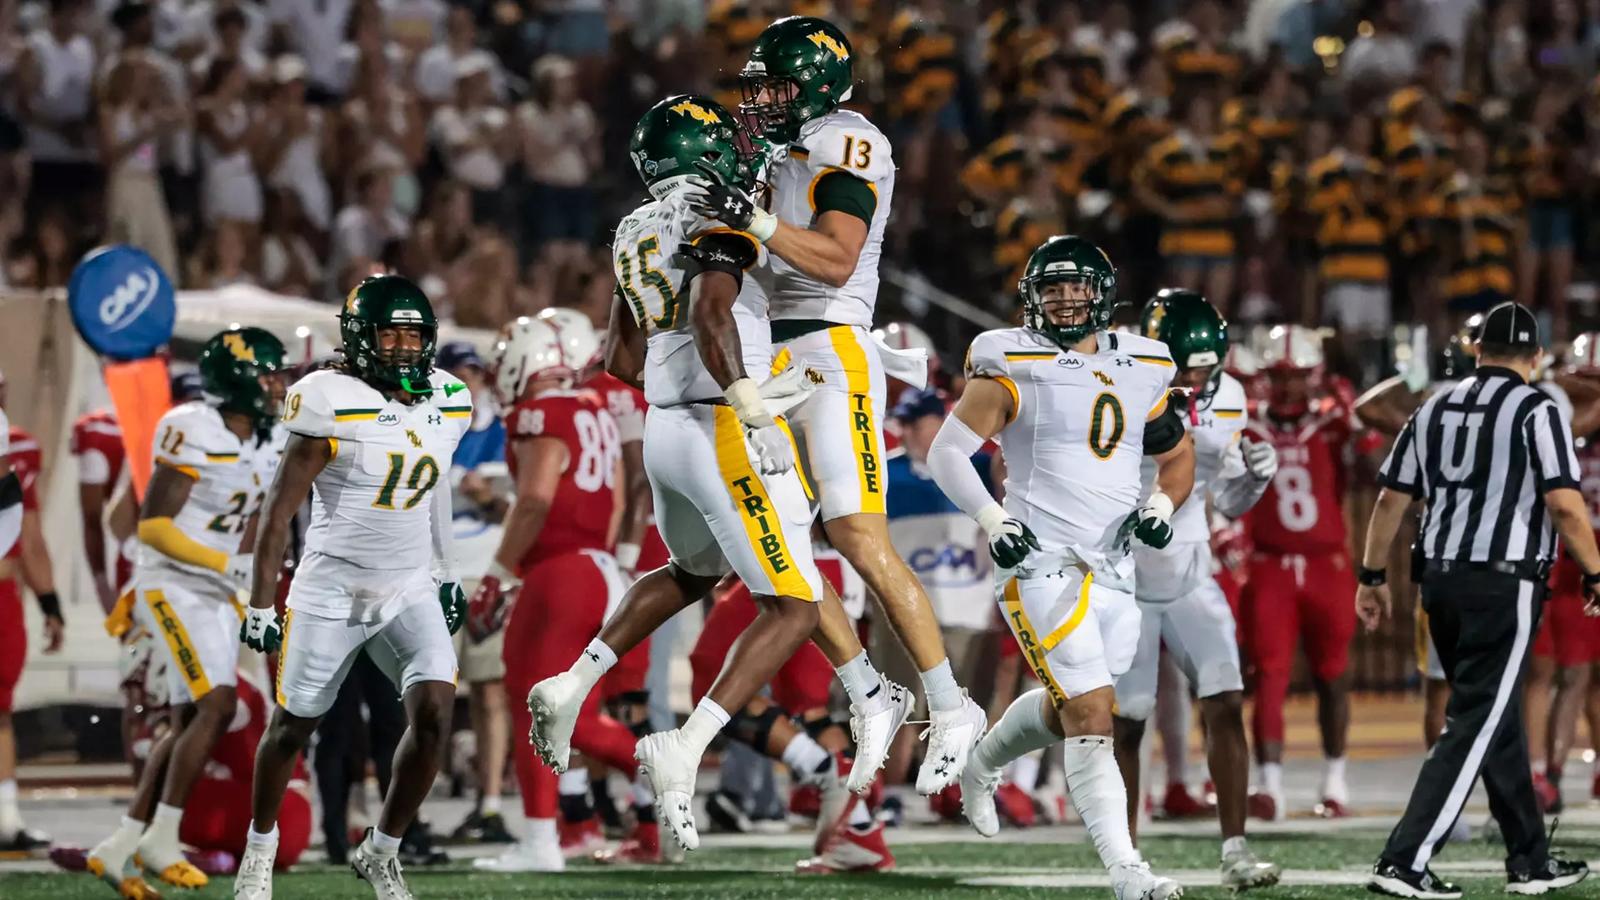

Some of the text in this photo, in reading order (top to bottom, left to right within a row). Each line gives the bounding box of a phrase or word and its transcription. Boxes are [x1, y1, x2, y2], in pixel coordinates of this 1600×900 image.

[840, 135, 872, 170] 13
[616, 233, 677, 330] 15
[1058, 358, 1081, 366] CAA
[377, 413, 398, 423] CAA
[573, 410, 624, 493] 88
[853, 393, 879, 494] TRIBE
[1088, 391, 1126, 461] 0
[1439, 410, 1485, 482] U
[371, 451, 440, 511] 19
[1274, 466, 1319, 532] 8
[732, 476, 790, 575] TRIBE
[154, 600, 200, 682] TRIBE
